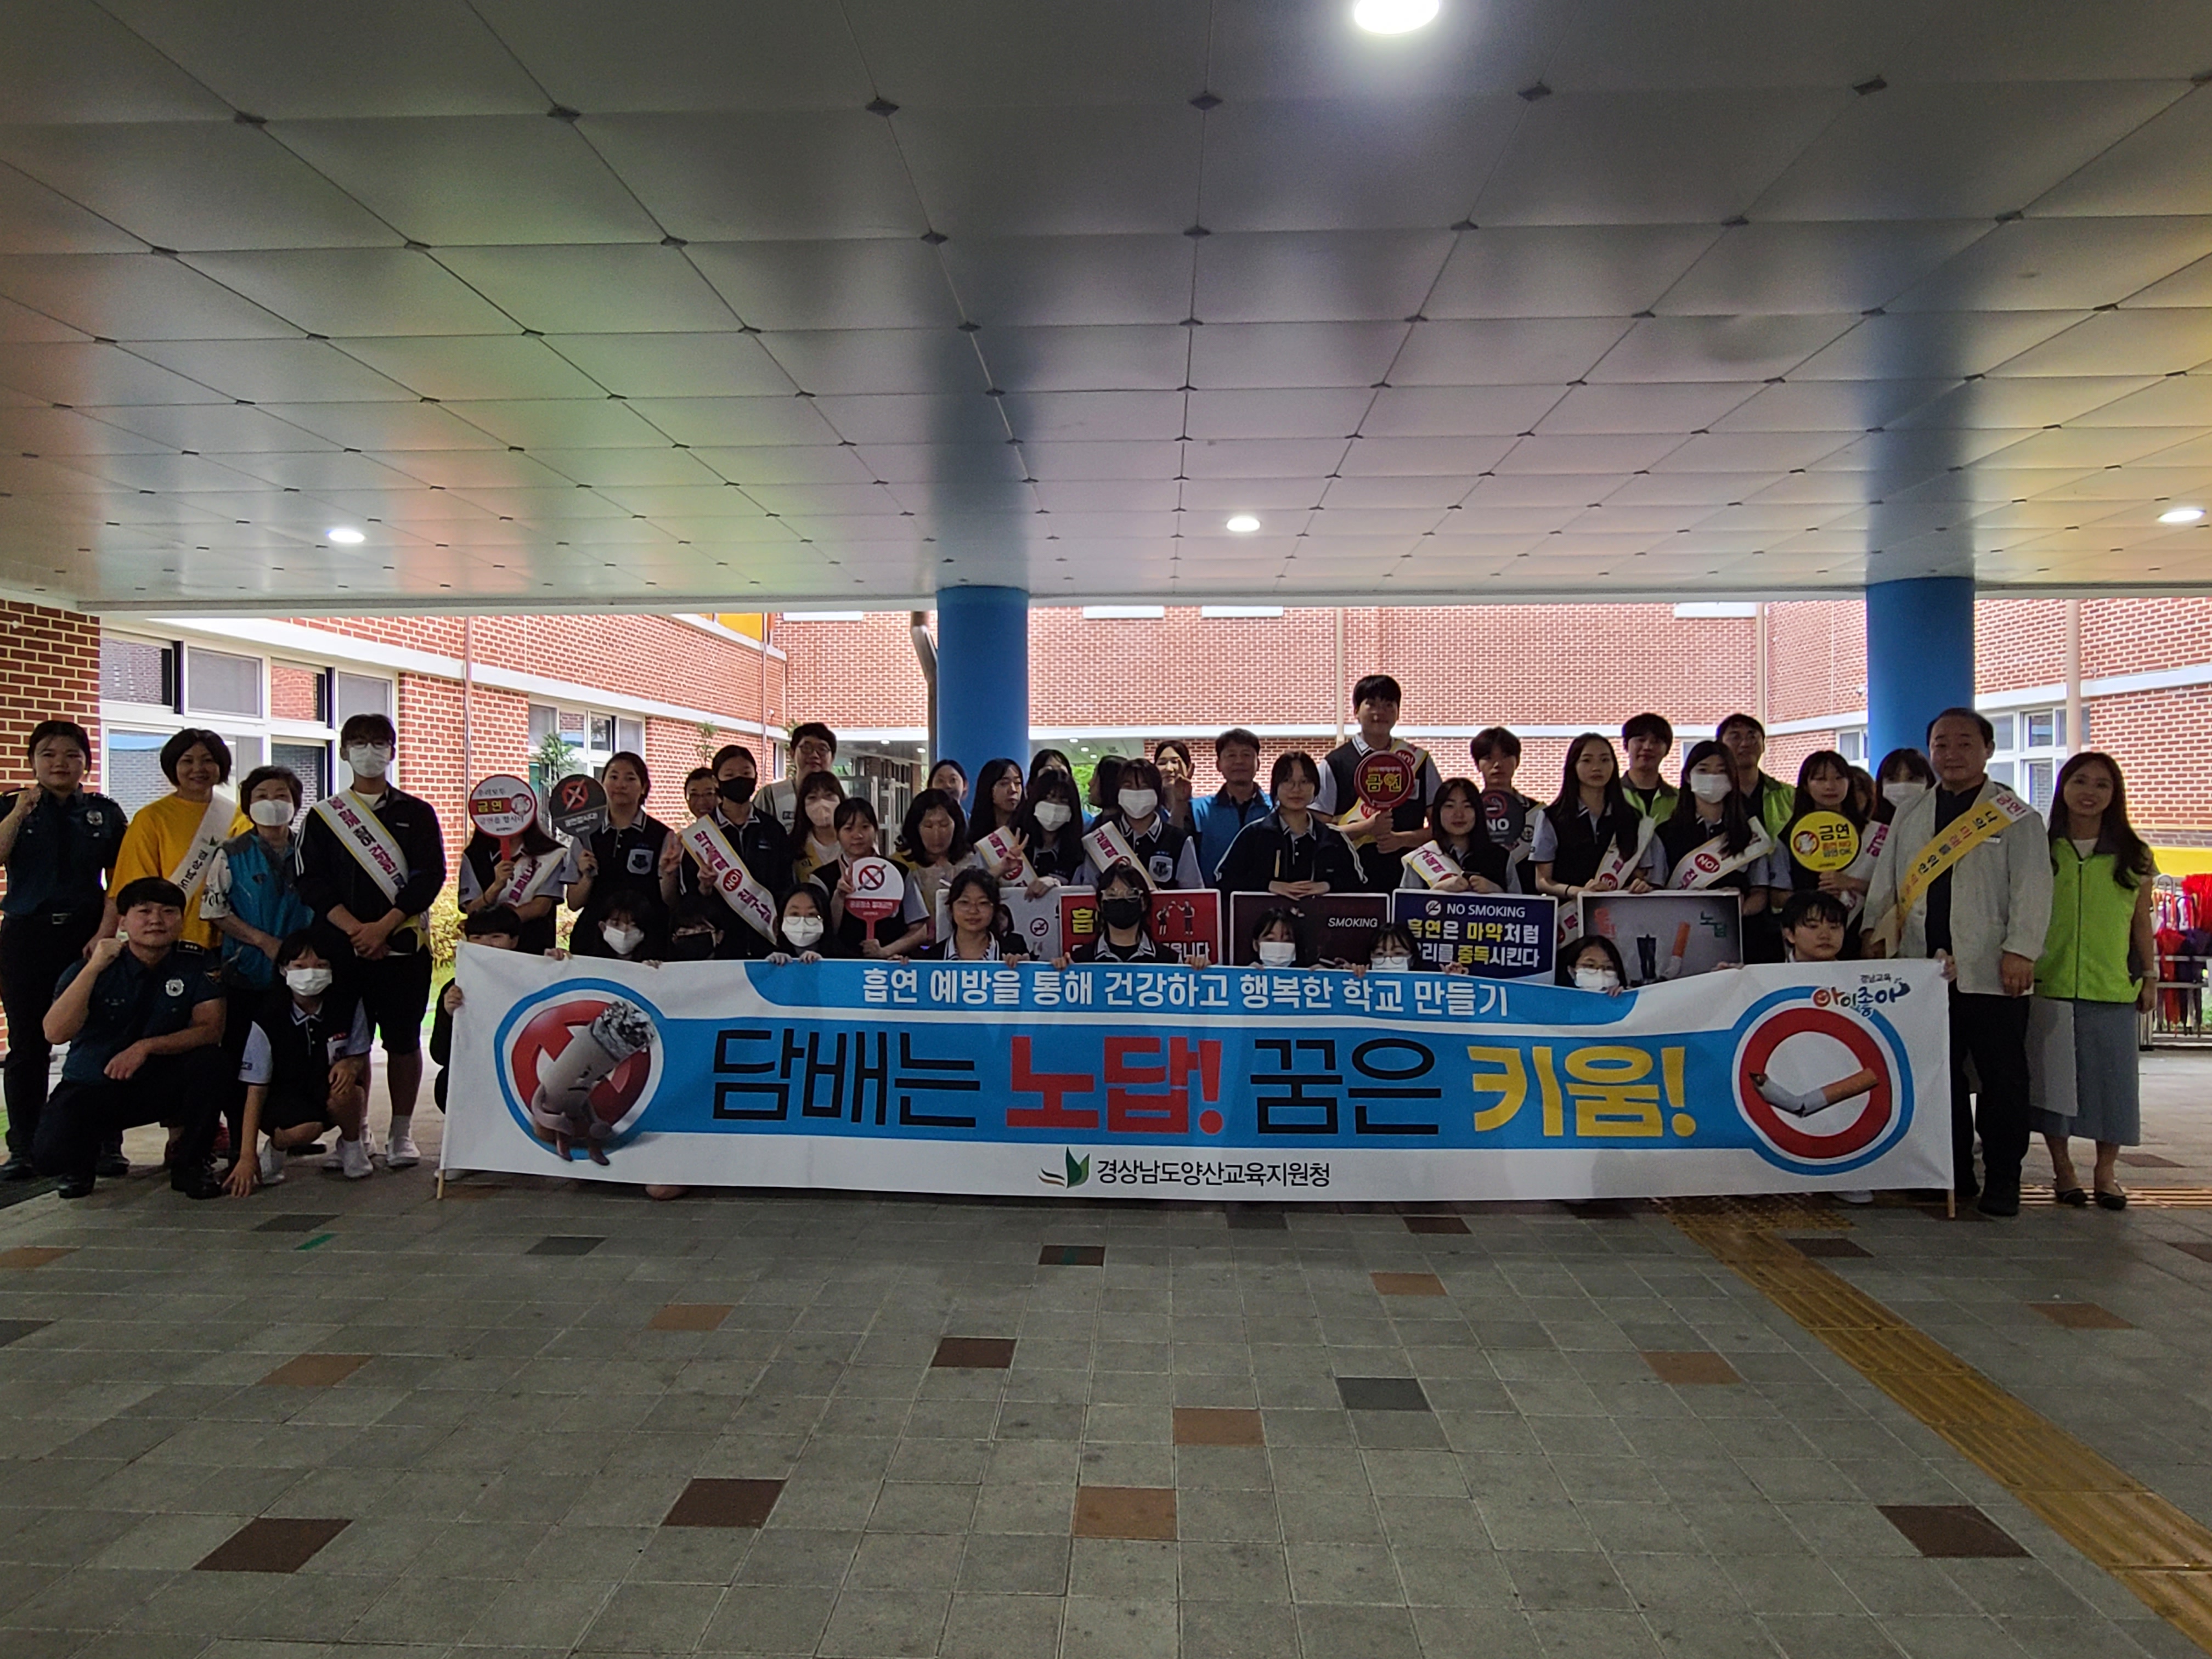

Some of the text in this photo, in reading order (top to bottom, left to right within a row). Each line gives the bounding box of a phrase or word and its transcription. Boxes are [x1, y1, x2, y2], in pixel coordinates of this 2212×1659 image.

[477, 800, 503, 813] 금연
[1996, 793, 2027, 817] 금연!
[1486, 817, 1510, 832] NO
[1971, 810, 1998, 831] 나의
[1819, 823, 1849, 841] 금연
[1696, 854, 1719, 873] NO!
[1917, 853, 1940, 875] 위한
[725, 871, 742, 890] NO!
[1071, 907, 1098, 934] 흡
[1447, 903, 1525, 918] NO SMOKING
[1328, 917, 1378, 928] SMOKING
[1407, 918, 1539, 944] 흡연은 마약처럼
[1417, 943, 1540, 967] 리를 중독시킨다
[863, 968, 1508, 1017] 흡연 예방을 통해 건강하고 행복한 학교 만들기
[713, 1028, 1697, 1138] 담배는 노답! 꿈은 키움!
[1097, 1159, 1330, 1187] 경상남도양산교육지원청
